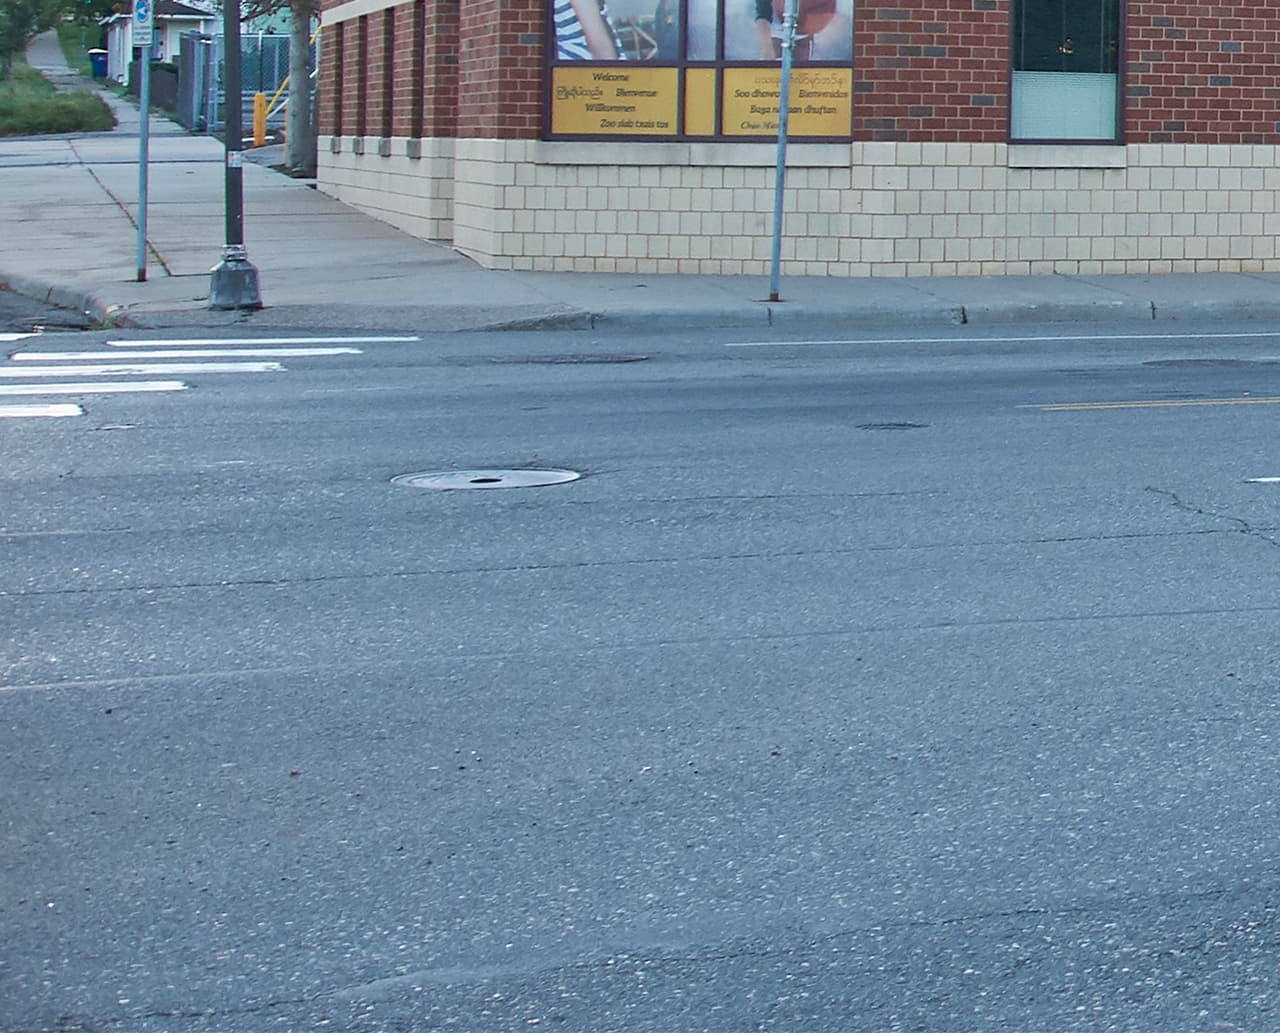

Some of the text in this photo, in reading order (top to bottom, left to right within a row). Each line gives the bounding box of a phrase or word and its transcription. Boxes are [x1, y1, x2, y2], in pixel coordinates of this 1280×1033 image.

[592, 72, 630, 82] Welcome
[616, 87, 658, 98] Bienvenue
[735, 88, 749, 98] Soo
[798, 88, 848, 99] Bienvenidos
[585, 103, 637, 113] Willkommen
